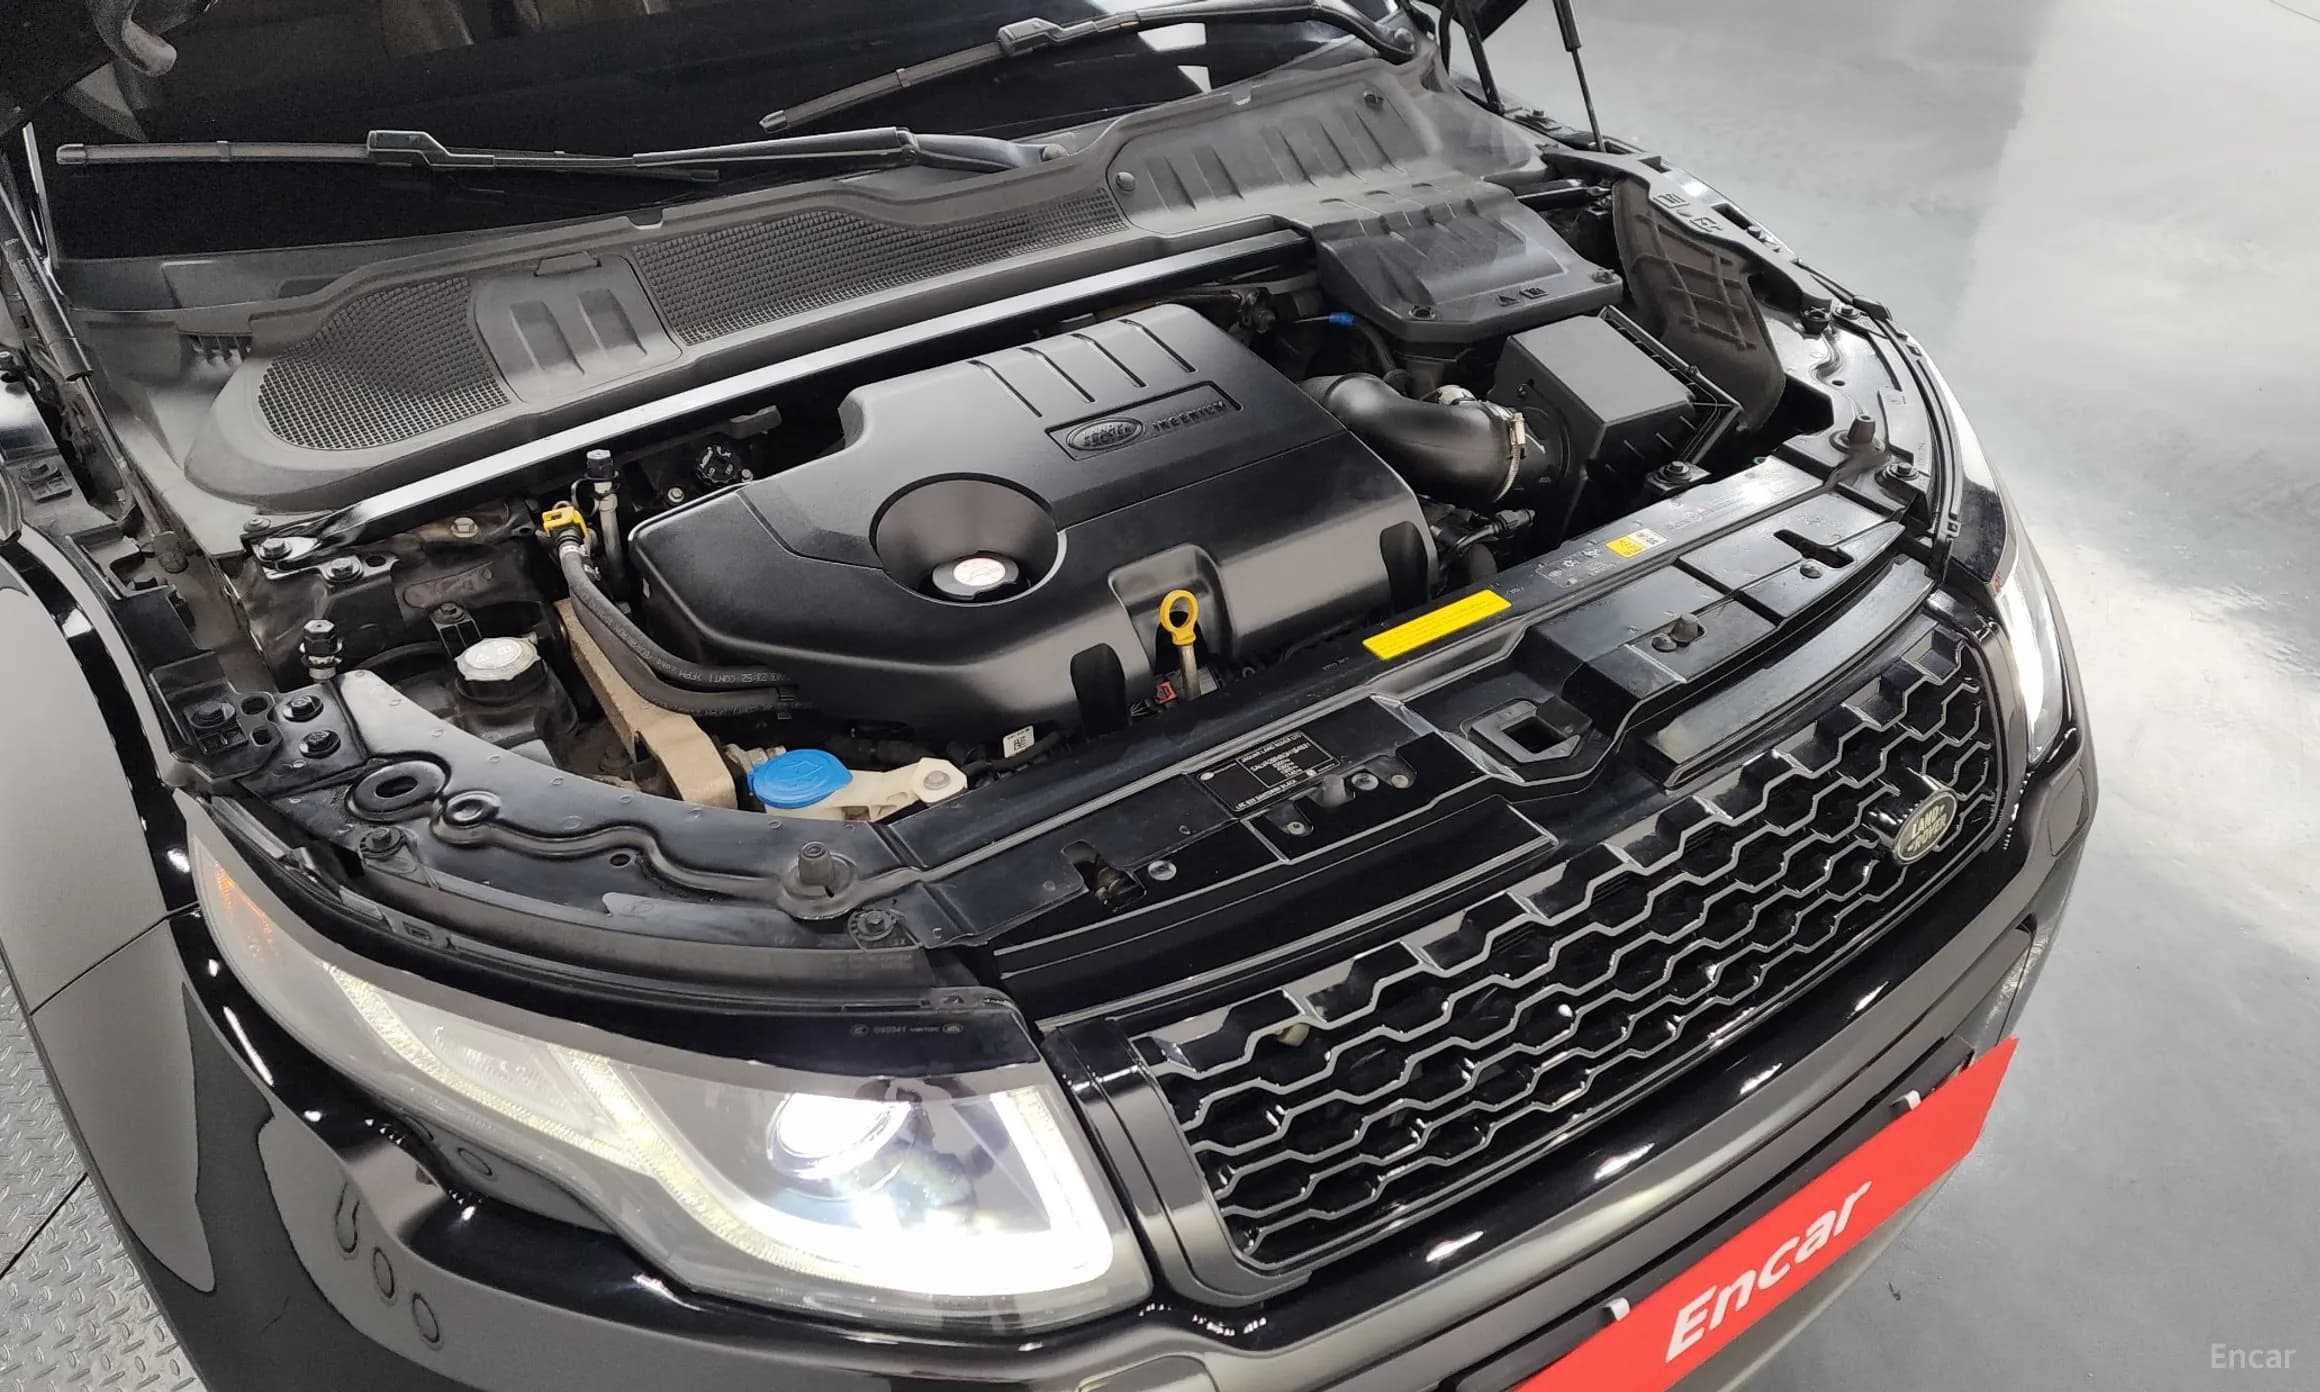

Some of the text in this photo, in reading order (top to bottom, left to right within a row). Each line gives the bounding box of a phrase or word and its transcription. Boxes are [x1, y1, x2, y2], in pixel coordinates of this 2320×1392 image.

[1912, 805, 1941, 839] LAND
[1913, 812, 1948, 852] ROVER
[1665, 1180, 1872, 1364] Encar
